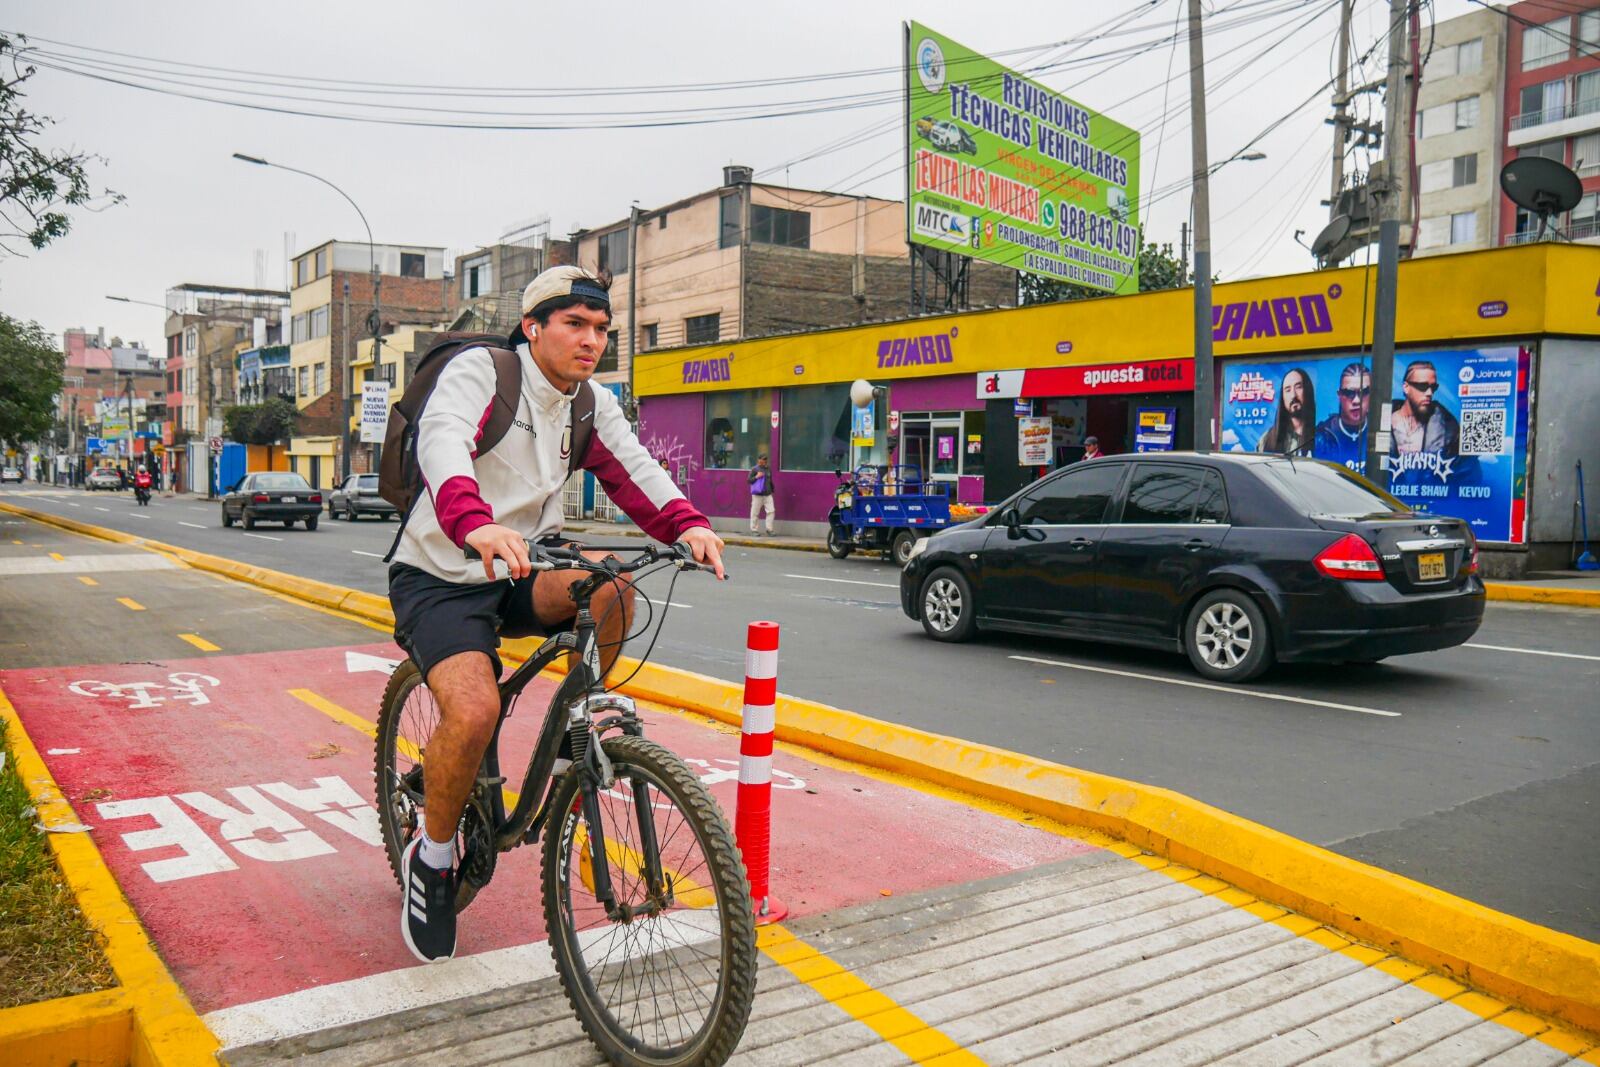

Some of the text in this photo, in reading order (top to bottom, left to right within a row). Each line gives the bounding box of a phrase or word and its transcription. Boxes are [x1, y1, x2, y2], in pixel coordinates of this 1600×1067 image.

[1004, 73, 1089, 139] REVISIONES
[950, 83, 1127, 186] TÉCNICAS VEHICULARES
[962, 164, 986, 206] LAS
[989, 173, 1039, 225] MULTAS!
[918, 206, 949, 232] MTC
[1061, 202, 1137, 259] 988 843 497
[1064, 244, 1091, 265] SAMUEL
[1036, 256, 1068, 279] ESPALDA
[1070, 267, 1081, 281] DEL
[1231, 381, 1273, 392] MUSIC
[1240, 372, 1264, 381] ALL
[1476, 370, 1512, 378] Joinnus
[1235, 408, 1267, 417] 31.05
[1388, 450, 1455, 484] JHAYCO
[1391, 485, 1491, 498] LESLIE SHAW KEVVO
[94, 774, 390, 883] ARE
[560, 812, 576, 881] FLASH
